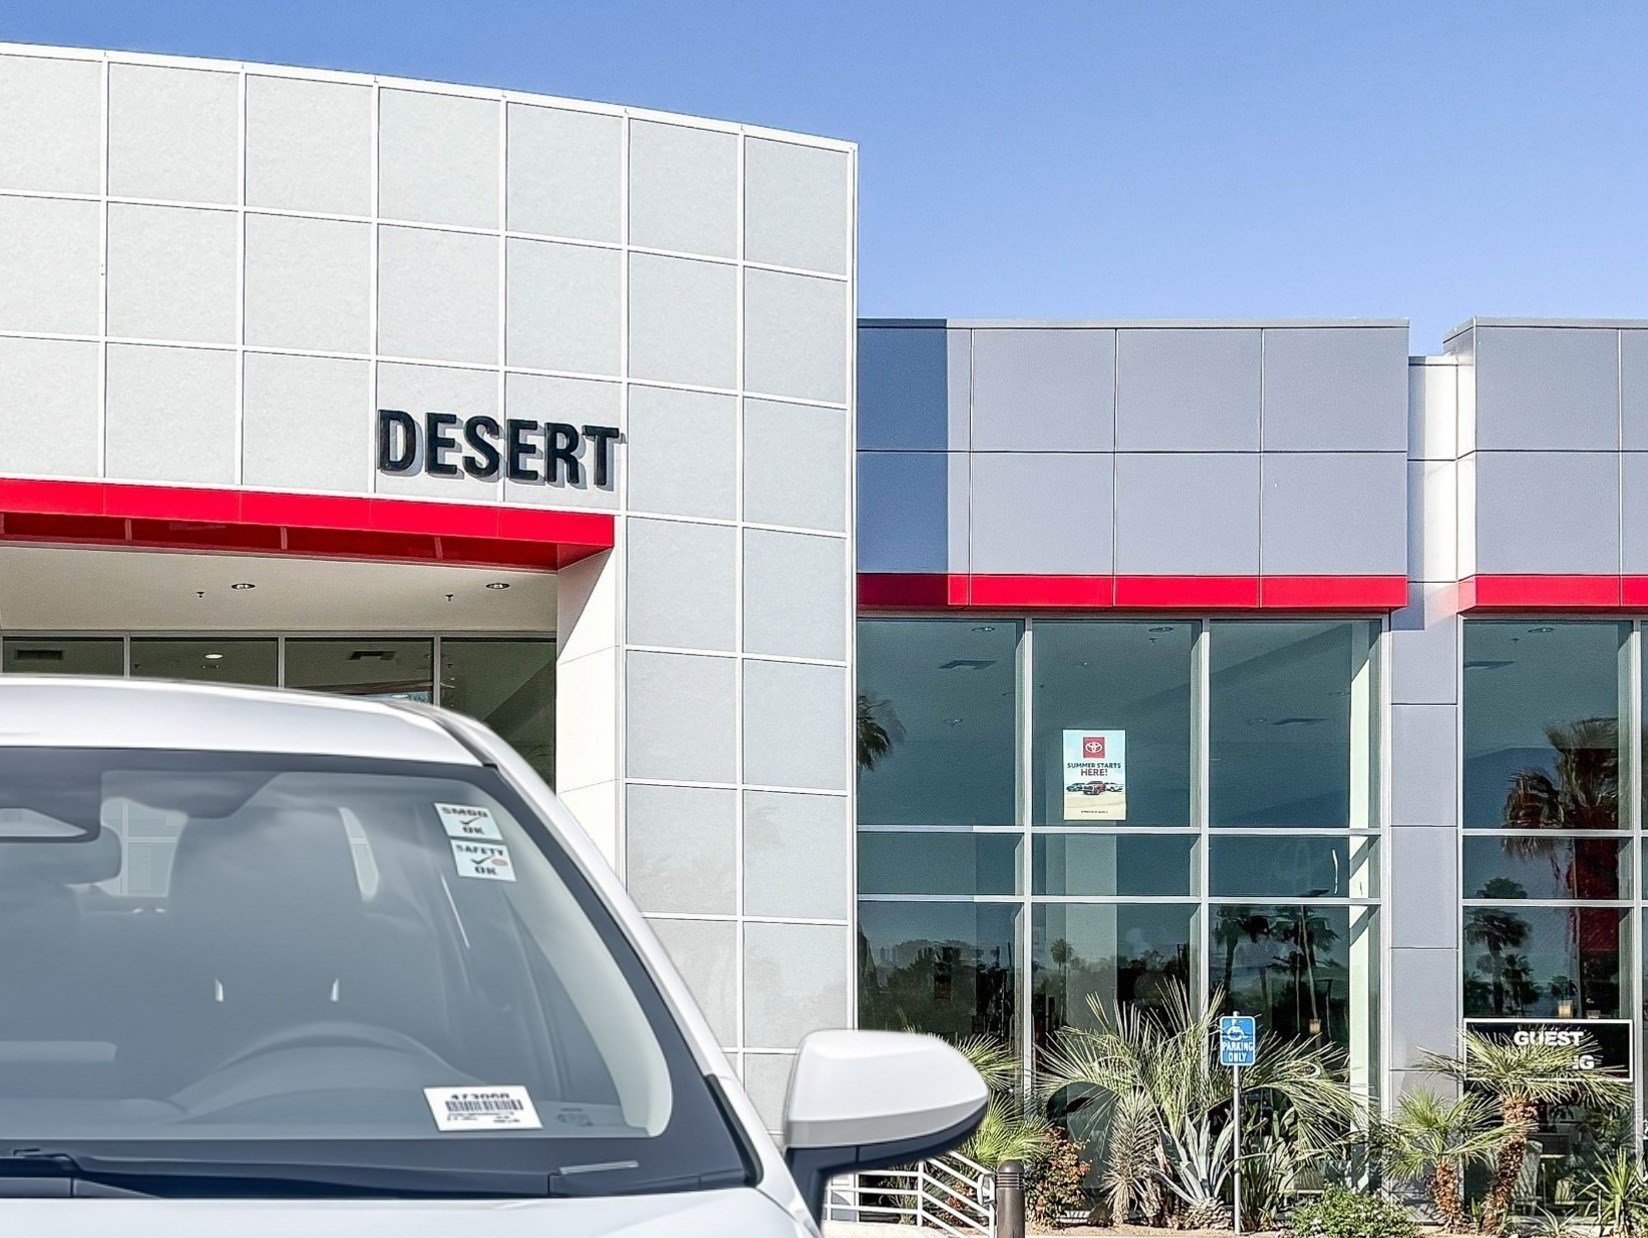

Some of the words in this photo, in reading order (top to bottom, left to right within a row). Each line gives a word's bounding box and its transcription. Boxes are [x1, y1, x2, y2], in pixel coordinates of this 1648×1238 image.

[377, 409, 620, 487] DESERT
[456, 845, 504, 856] SAFETY
[1513, 1031, 1584, 1046] GUEST
[1223, 1041, 1253, 1051] PARKING
[1228, 1052, 1247, 1062] ONLY
